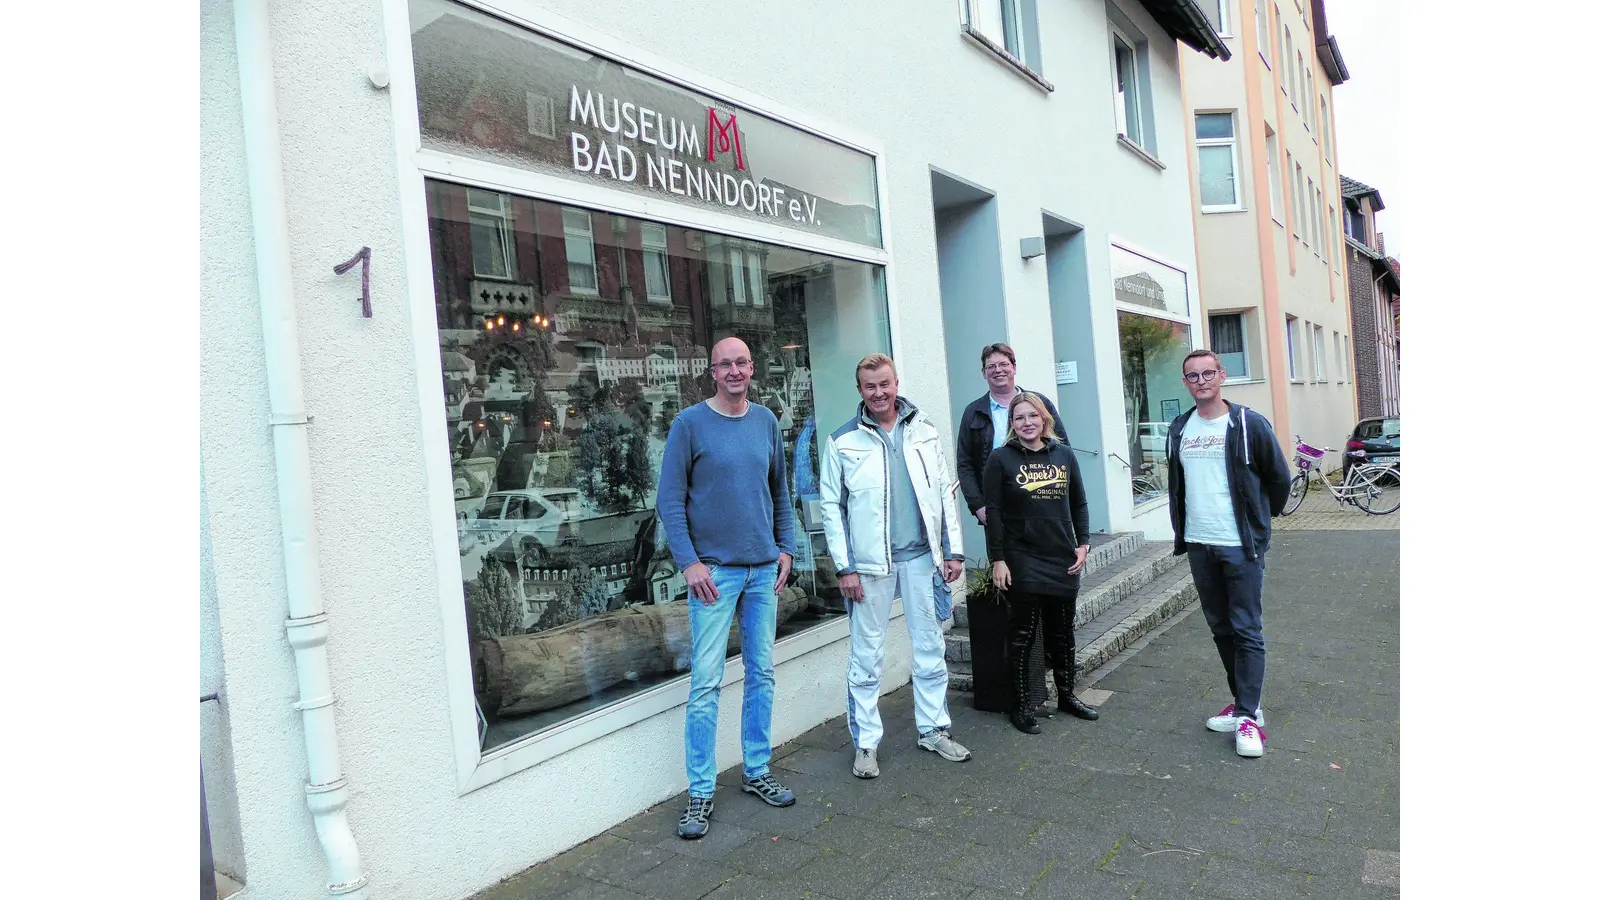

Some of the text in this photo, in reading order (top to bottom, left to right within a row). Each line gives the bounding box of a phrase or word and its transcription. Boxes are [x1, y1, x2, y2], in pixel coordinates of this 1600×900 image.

[569, 84, 702, 158] MUSEUM
[571, 132, 821, 226] BAD NENNDORF e.V.
[333, 246, 373, 318] 1
